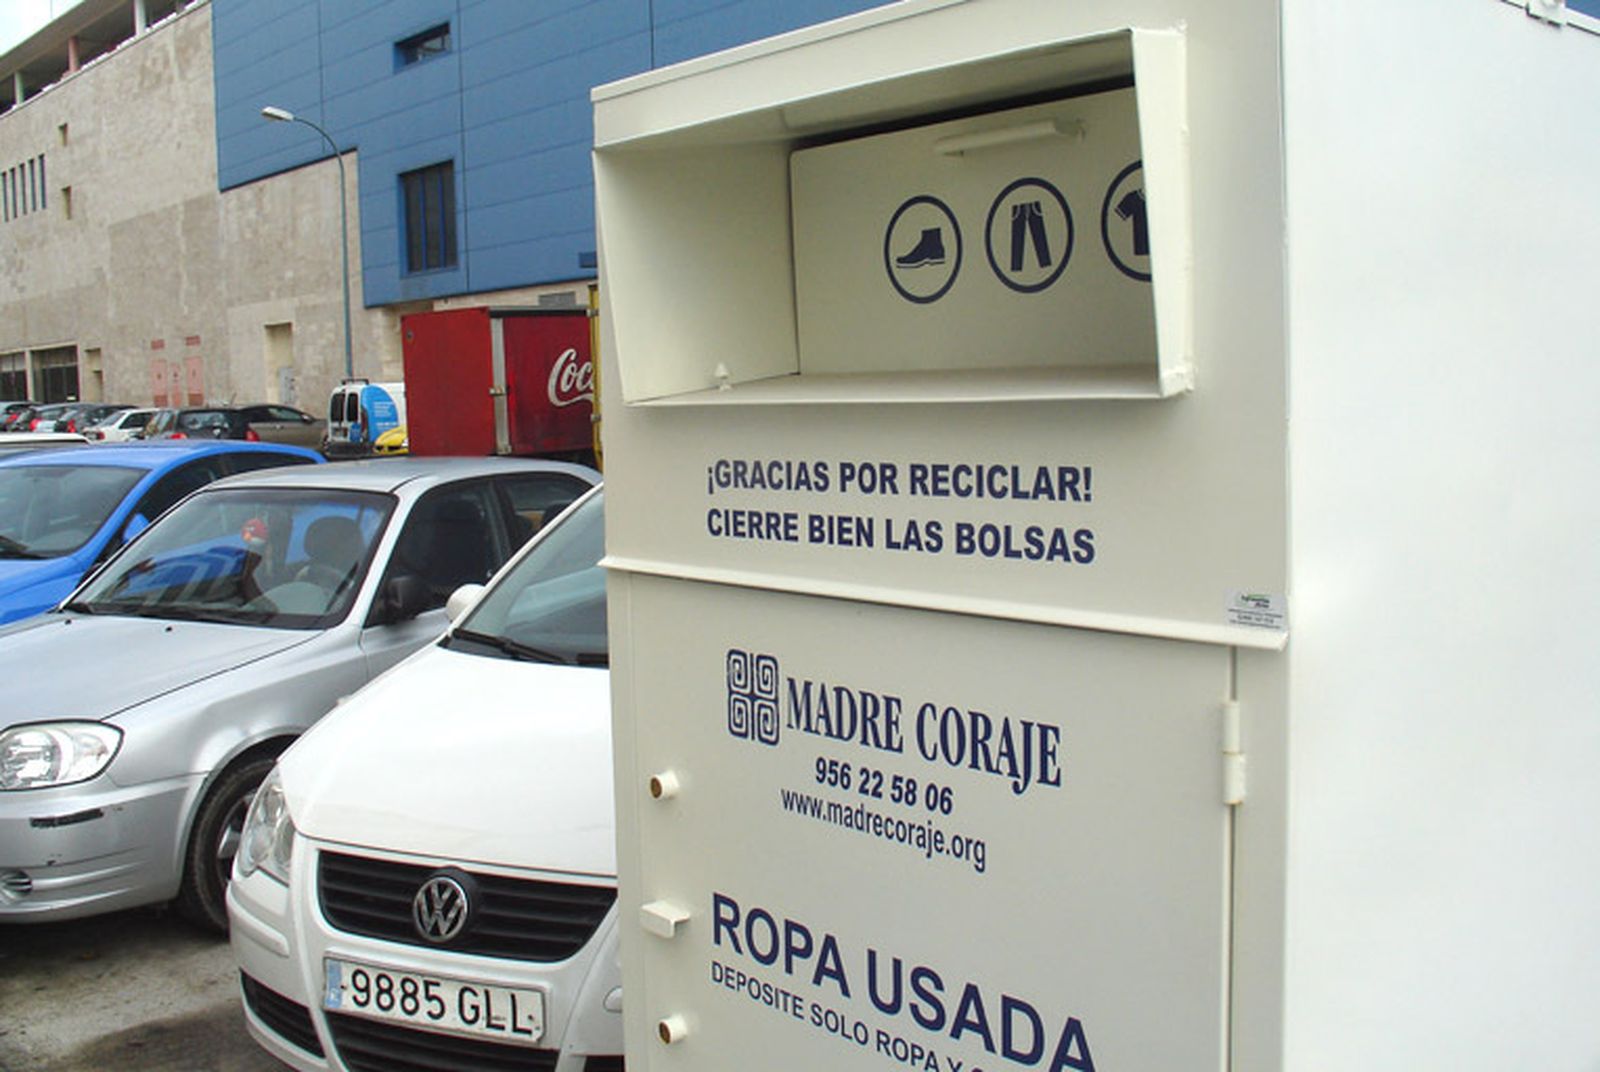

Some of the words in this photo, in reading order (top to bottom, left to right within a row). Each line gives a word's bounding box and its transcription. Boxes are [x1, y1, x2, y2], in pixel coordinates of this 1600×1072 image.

[707, 459, 830, 495] ¡GRACIAS
[839, 461, 899, 495] POR
[909, 463, 1093, 502] RECICLAR!
[707, 508, 799, 543] CIERRE
[808, 514, 874, 548] BIEN
[885, 518, 944, 554] LAS
[955, 522, 1096, 564] BOLSAS
[786, 677, 904, 754] MADRE
[916, 702, 1061, 795] CORAJE
[815, 756, 852, 791] 956
[858, 767, 884, 799] 22
[890, 774, 918, 807] 58
[924, 783, 953, 816] 06
[781, 788, 986, 874] www.madrecoraje.org
[351, 968, 446, 1020] 9885
[458, 986, 533, 1036] GLL
[711, 960, 805, 1020] DEPOSITE
[810, 1003, 869, 1046] SOLO
[876, 1029, 940, 1072] ROPA
[712, 892, 851, 999] ROPA
[867, 948, 1097, 1072] USADA
